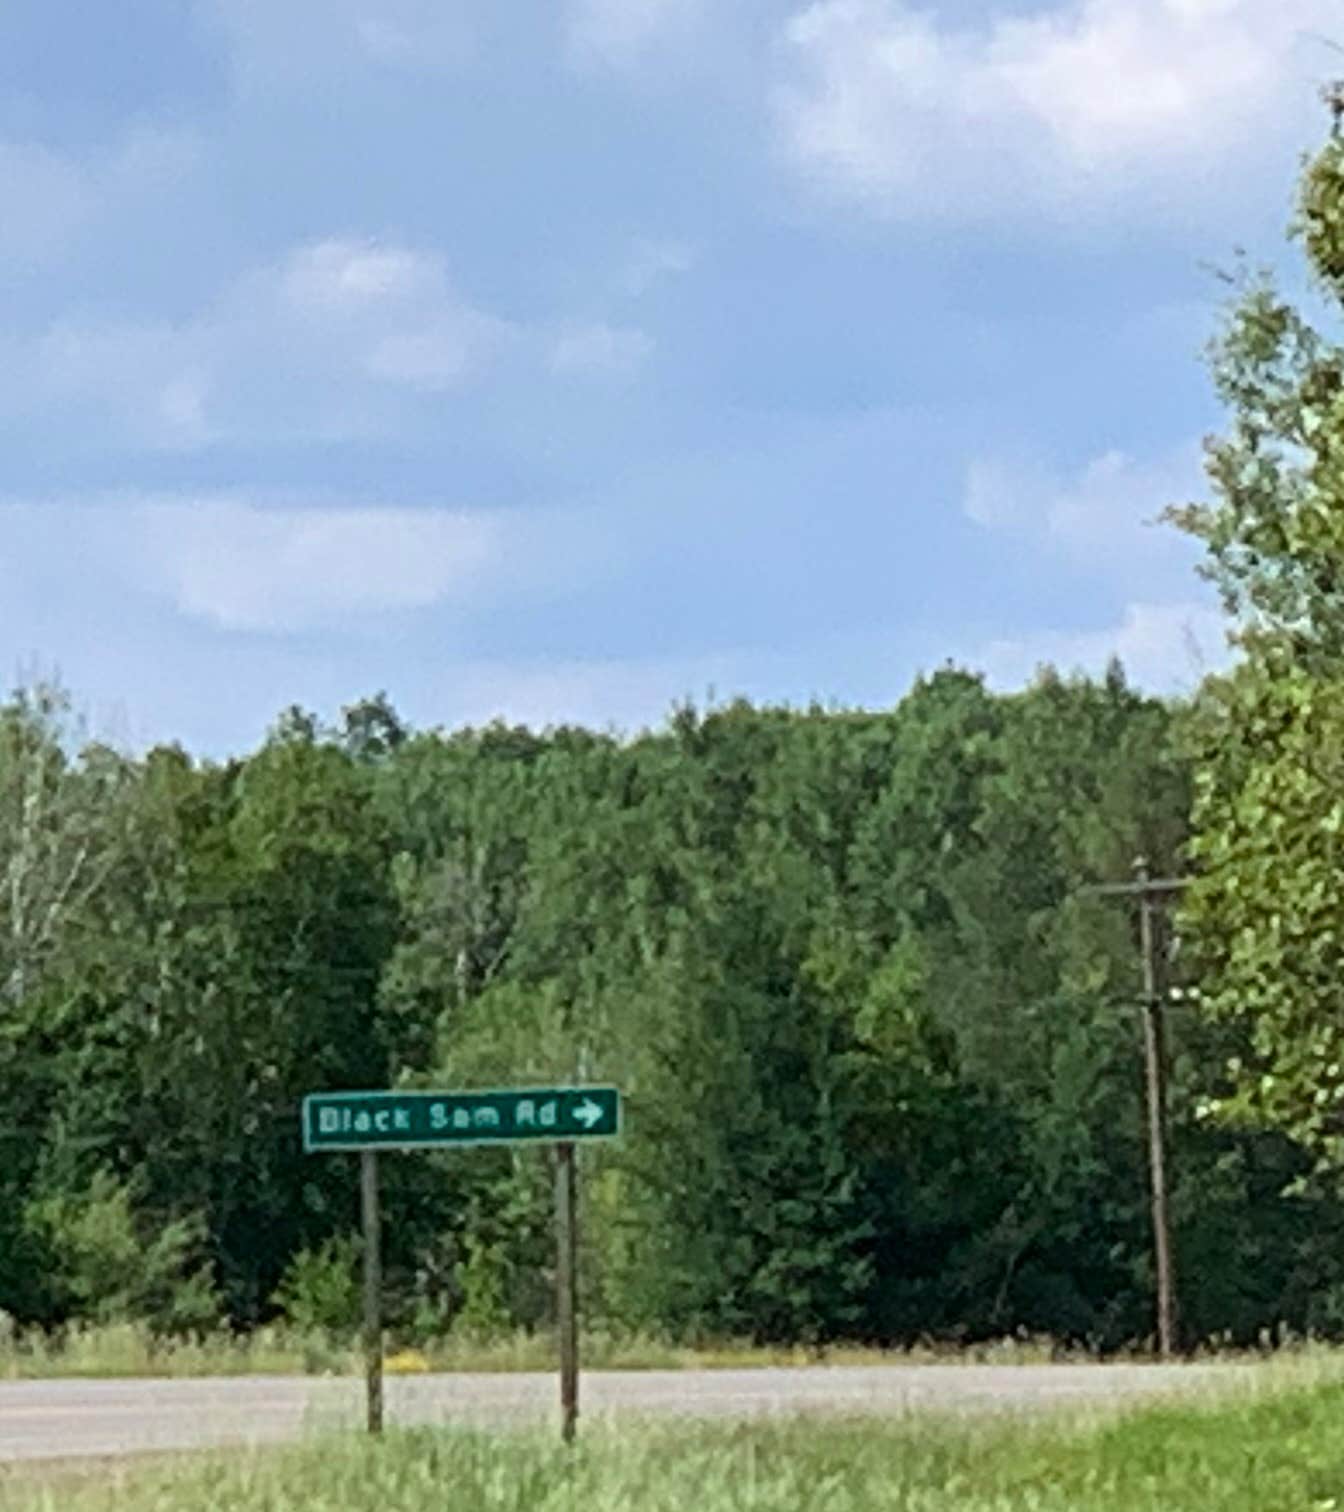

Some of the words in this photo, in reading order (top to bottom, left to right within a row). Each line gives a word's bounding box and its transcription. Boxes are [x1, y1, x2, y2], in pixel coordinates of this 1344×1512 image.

[319, 1107, 411, 1133] Black
[430, 1103, 501, 1129] Sam
[515, 1099, 557, 1126] Rd
